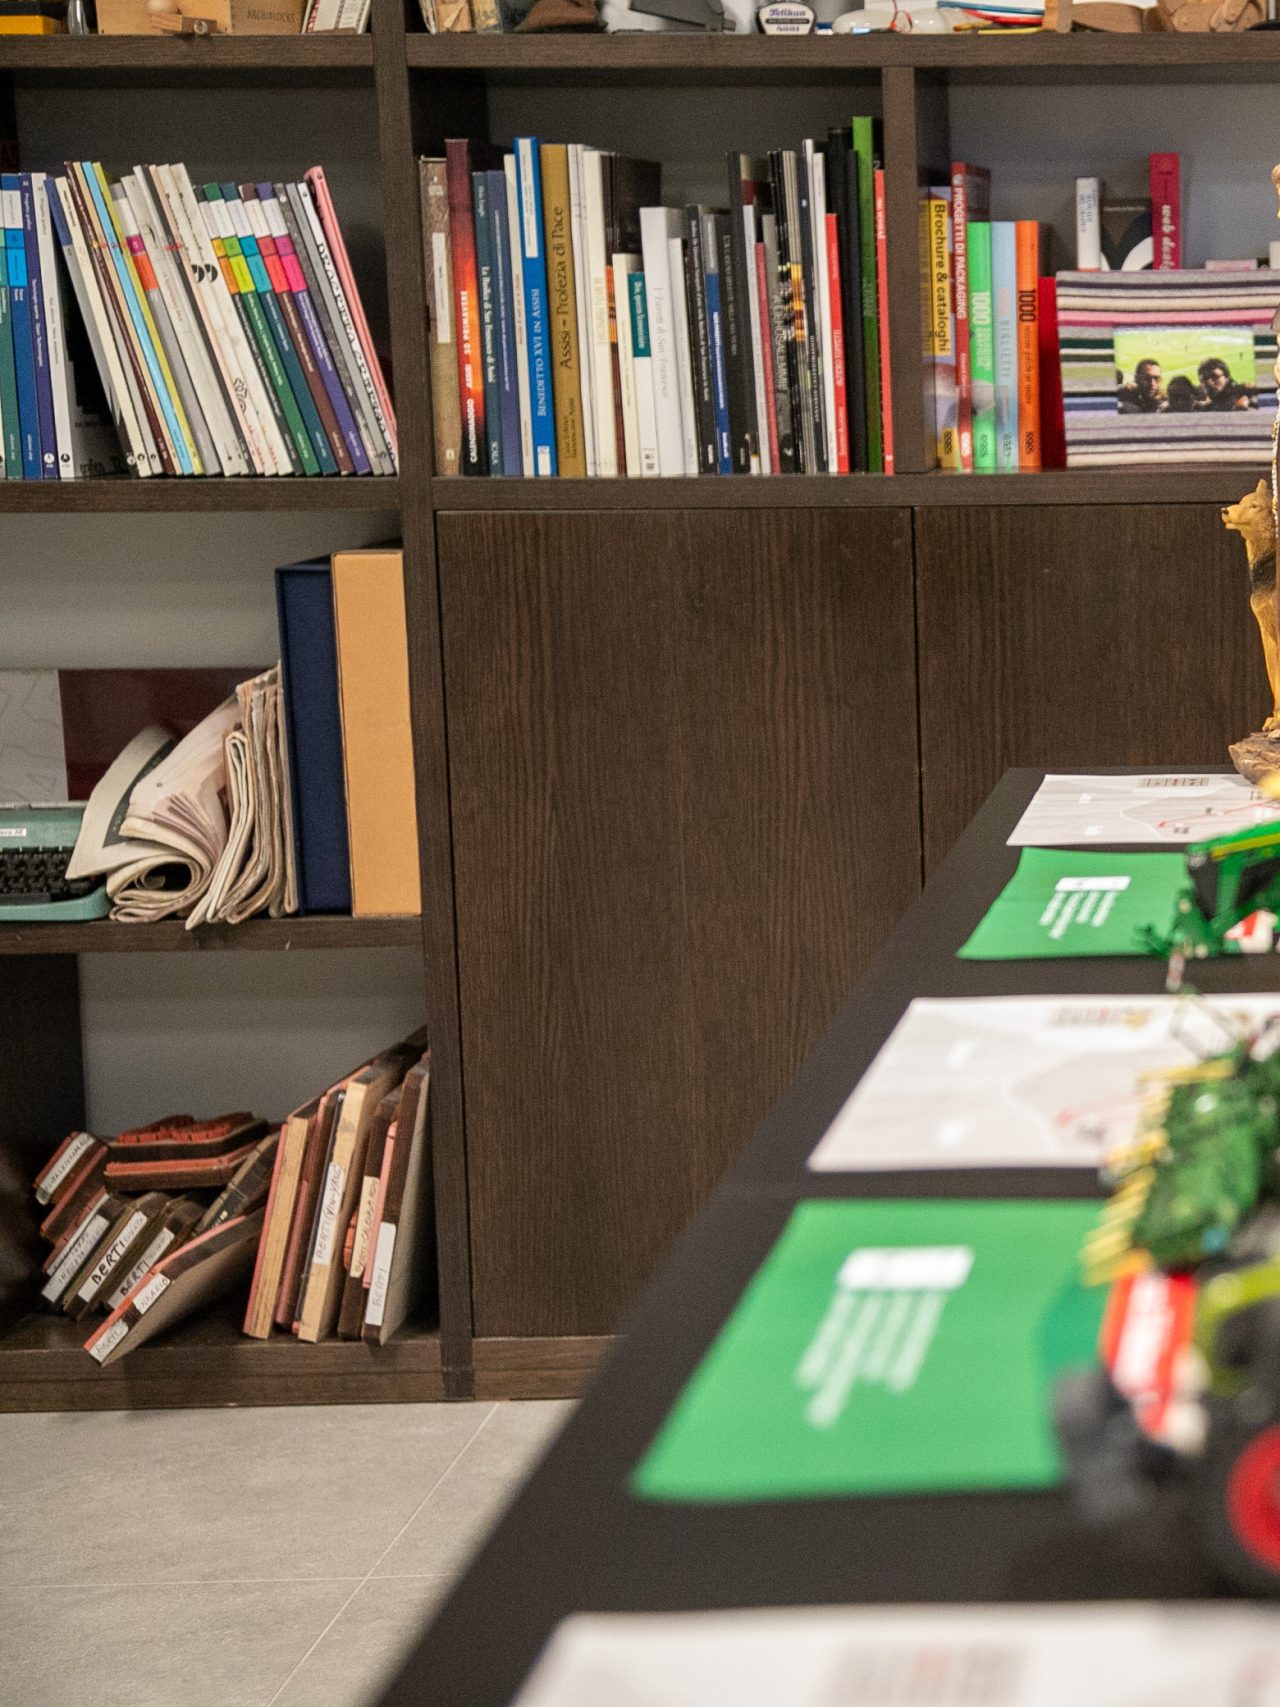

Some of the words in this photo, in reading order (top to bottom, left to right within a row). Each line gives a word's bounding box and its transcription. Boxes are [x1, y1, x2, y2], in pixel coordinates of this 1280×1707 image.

[551, 207, 565, 239] Pace
[953, 187, 965, 240] PROGETTI
[1161, 204, 1176, 233] web
[553, 243, 566, 257] di
[934, 204, 948, 268] Brochure
[955, 243, 965, 254] DI
[555, 261, 569, 315] Profezia
[936, 272, 948, 284] &
[955, 256, 967, 320] PACKAGING
[460, 291, 470, 341] PRIMAVERE
[484, 311, 493, 323] San
[531, 288, 541, 318] ASSISI
[935, 287, 950, 352] cataloghi
[971, 291, 991, 325] 1000
[1018, 288, 1036, 323] 1000
[533, 321, 542, 333] IN
[533, 337, 542, 356] XVI
[559, 330, 573, 370] Assisi
[464, 364, 473, 389] ASSISI
[537, 358, 547, 417] BENEDETTO
[466, 398, 478, 463] CALENDIMAGGIO
[91, 1240, 126, 1284] BERTI
[121, 1259, 150, 1297] BERTI
